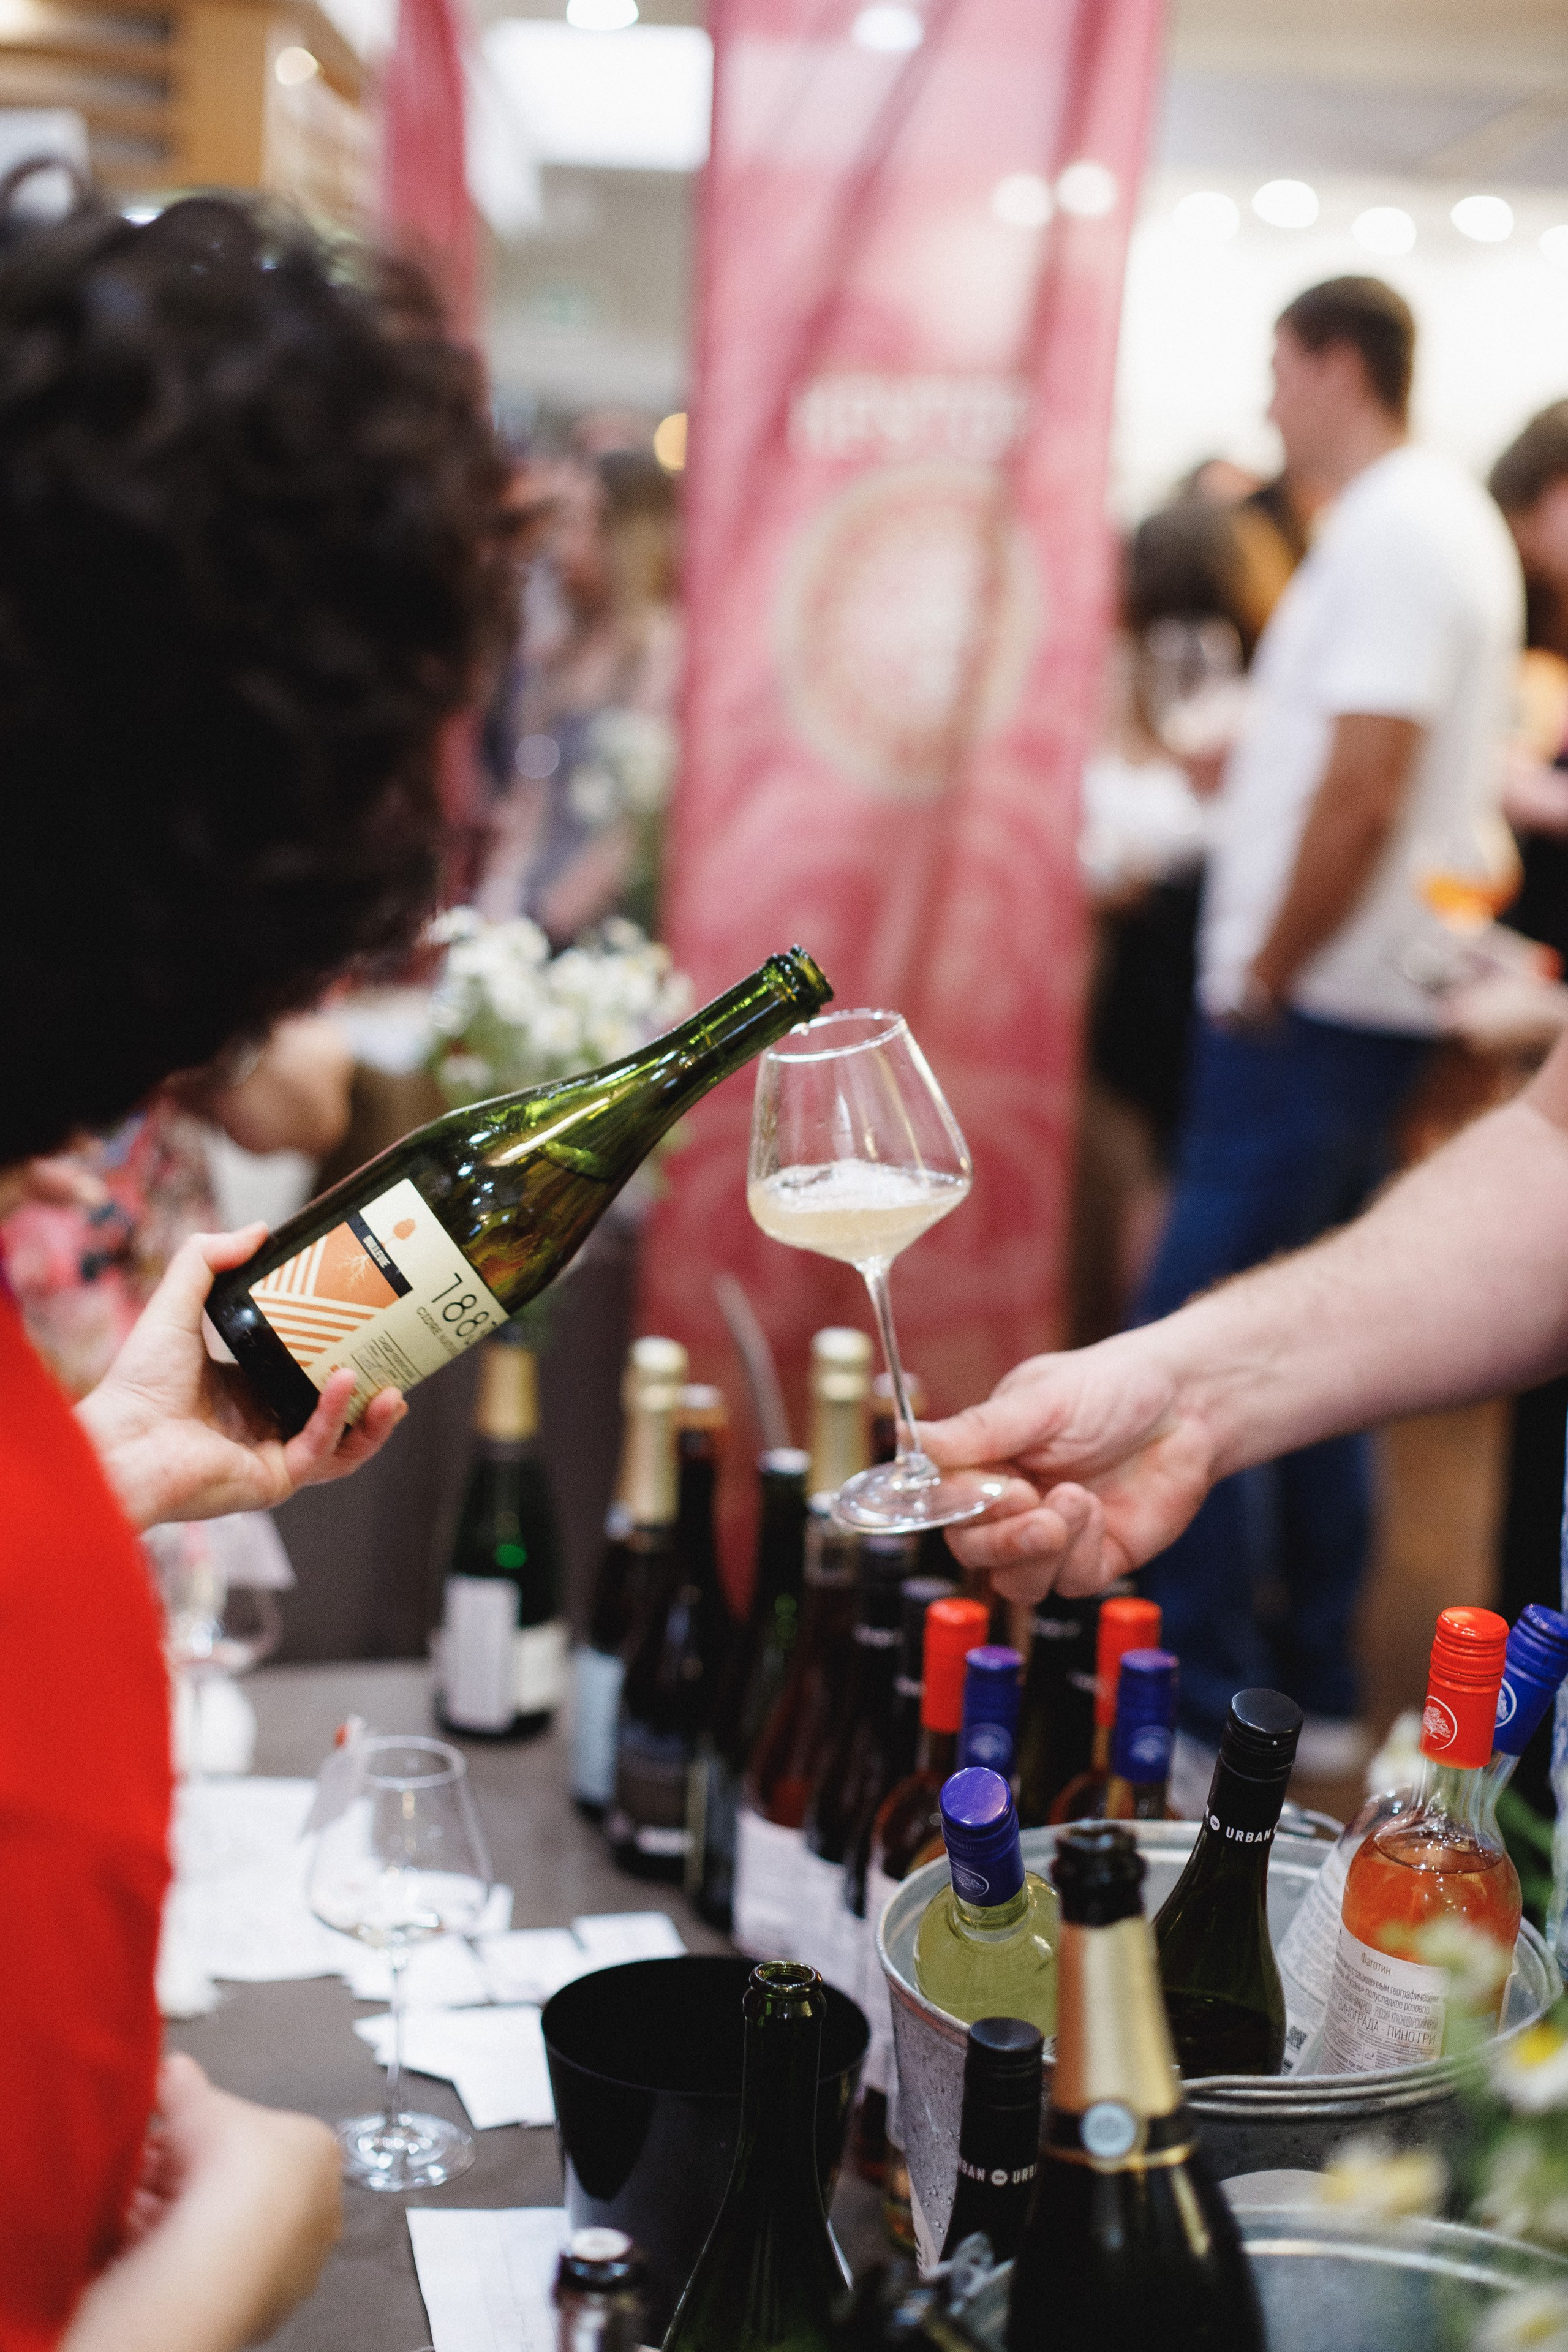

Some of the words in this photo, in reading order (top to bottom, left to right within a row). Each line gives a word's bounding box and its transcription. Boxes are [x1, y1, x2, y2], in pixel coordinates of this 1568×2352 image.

[417, 1306, 442, 1335] CIDRE
[1226, 1826, 1272, 1843] URBAN
[1361, 1952, 1392, 1976] Фаготин
[1355, 1969, 1390, 1992] защищенным
[1365, 1988, 1403, 2007] полусладкое
[1404, 2001, 1430, 2015] розовое
[1387, 2026, 1415, 2043] ПИНО
[1417, 2032, 1436, 2045] ГРИ
[957, 2157, 986, 2182] BAN
[1012, 2162, 1037, 2184] URB
